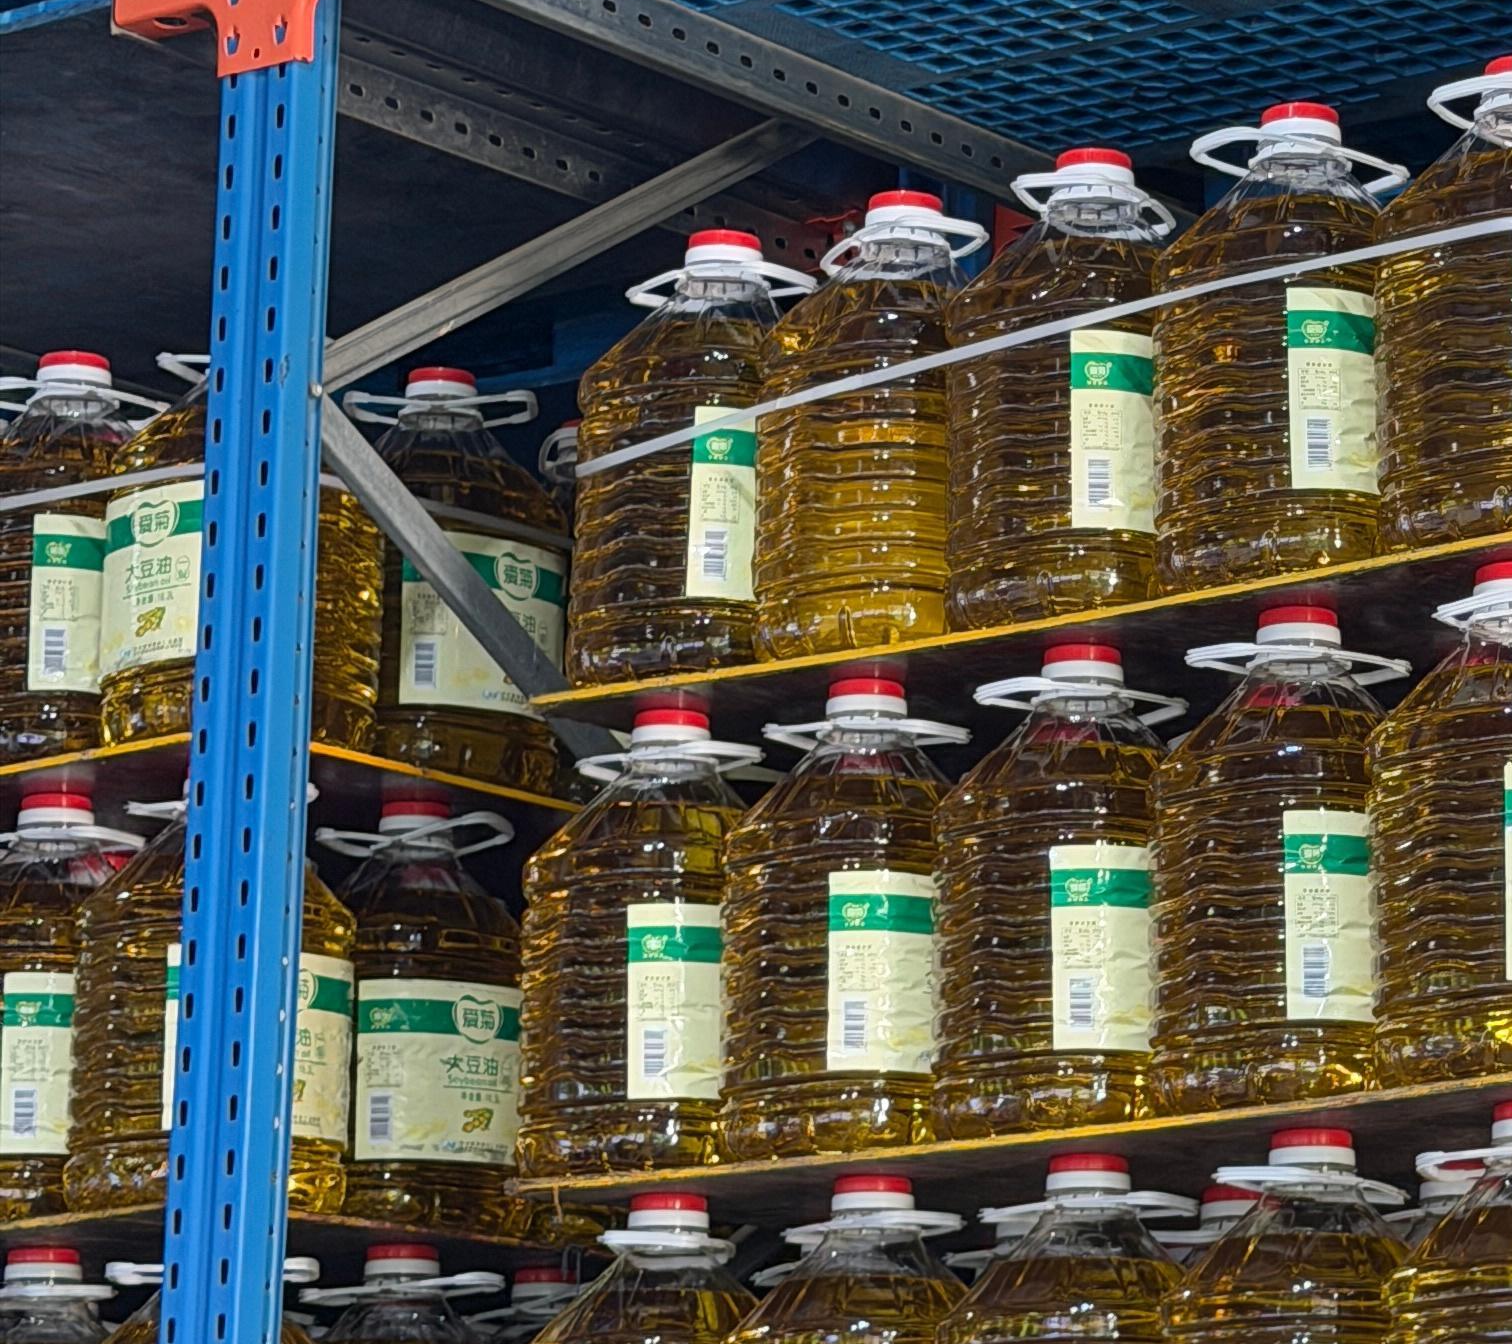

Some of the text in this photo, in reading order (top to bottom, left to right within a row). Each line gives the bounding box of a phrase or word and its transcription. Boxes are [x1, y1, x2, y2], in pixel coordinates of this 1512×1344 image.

[138, 509, 171, 535] 爱菊
[461, 1007, 496, 1031] 爱菊
[446, 1054, 499, 1077] 大豆油
